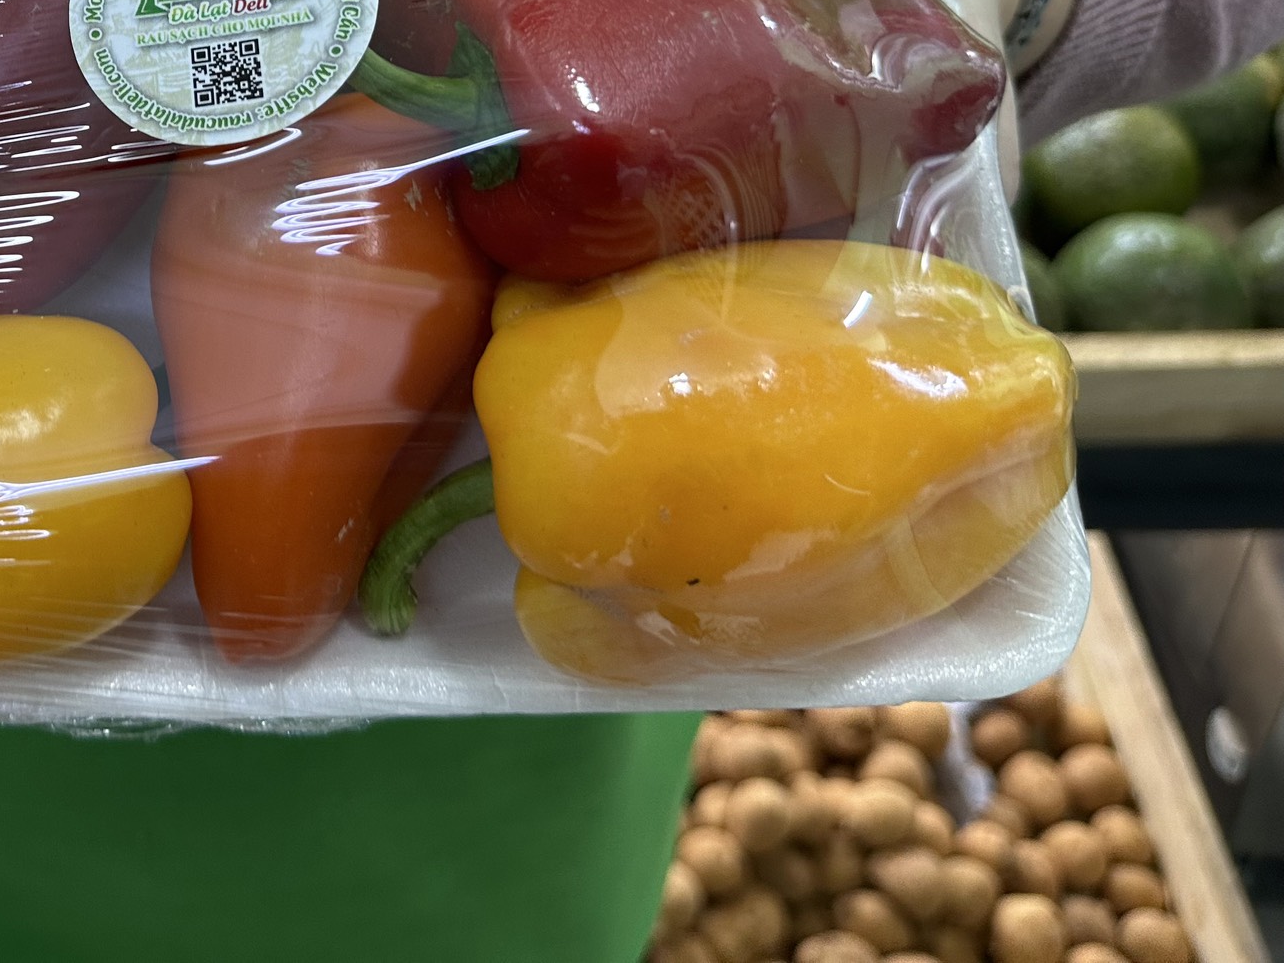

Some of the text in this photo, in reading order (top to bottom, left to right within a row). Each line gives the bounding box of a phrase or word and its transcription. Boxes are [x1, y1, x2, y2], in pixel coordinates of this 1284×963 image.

[170, 3, 196, 23] Đà
[200, 1, 229, 21] Lạt
[137, 31, 167, 45] RAU
[212, 21, 245, 36] CHO
[94, 48, 337, 130] Website: raucudalatdeli.com
